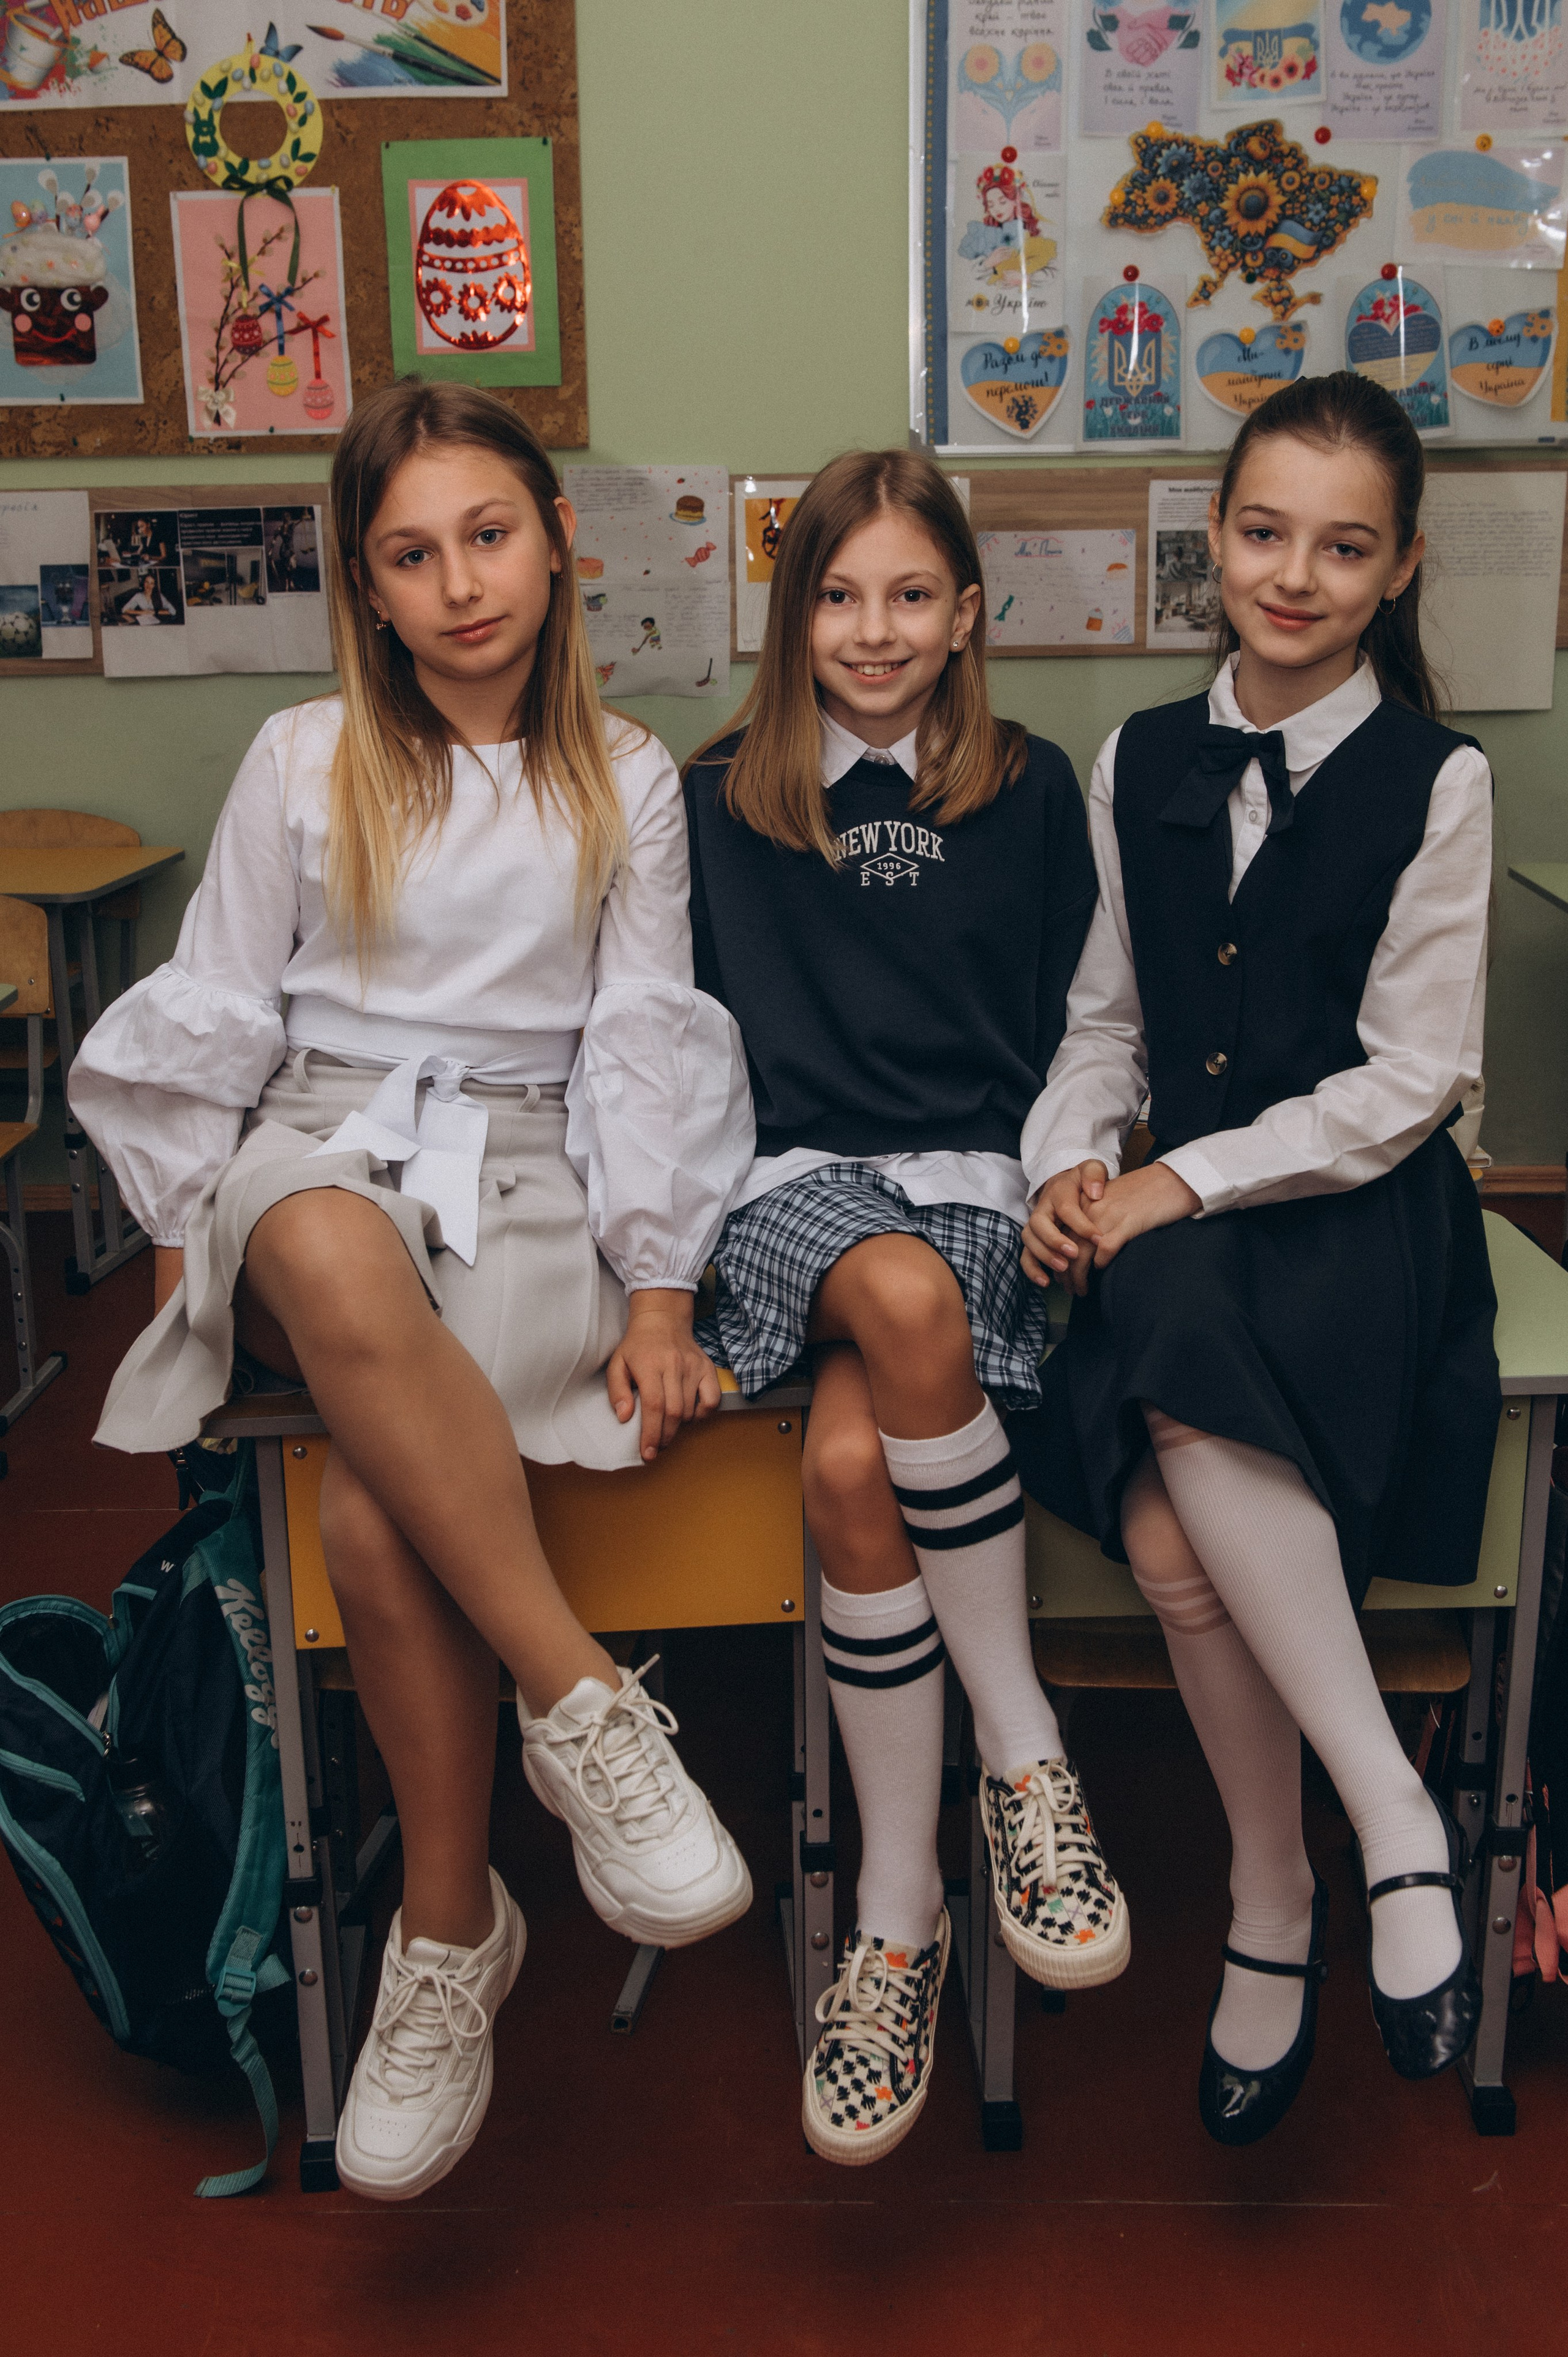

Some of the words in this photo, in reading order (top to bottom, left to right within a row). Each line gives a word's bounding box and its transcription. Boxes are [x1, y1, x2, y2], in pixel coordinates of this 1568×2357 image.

[1468, 336, 1480, 351] В
[983, 352, 1025, 375] Разом
[986, 371, 1049, 403] перемоги!
[1480, 379, 1526, 396] Україна
[833, 821, 881, 861] NEW
[883, 820, 945, 862] YORK
[876, 862, 902, 870] 1996
